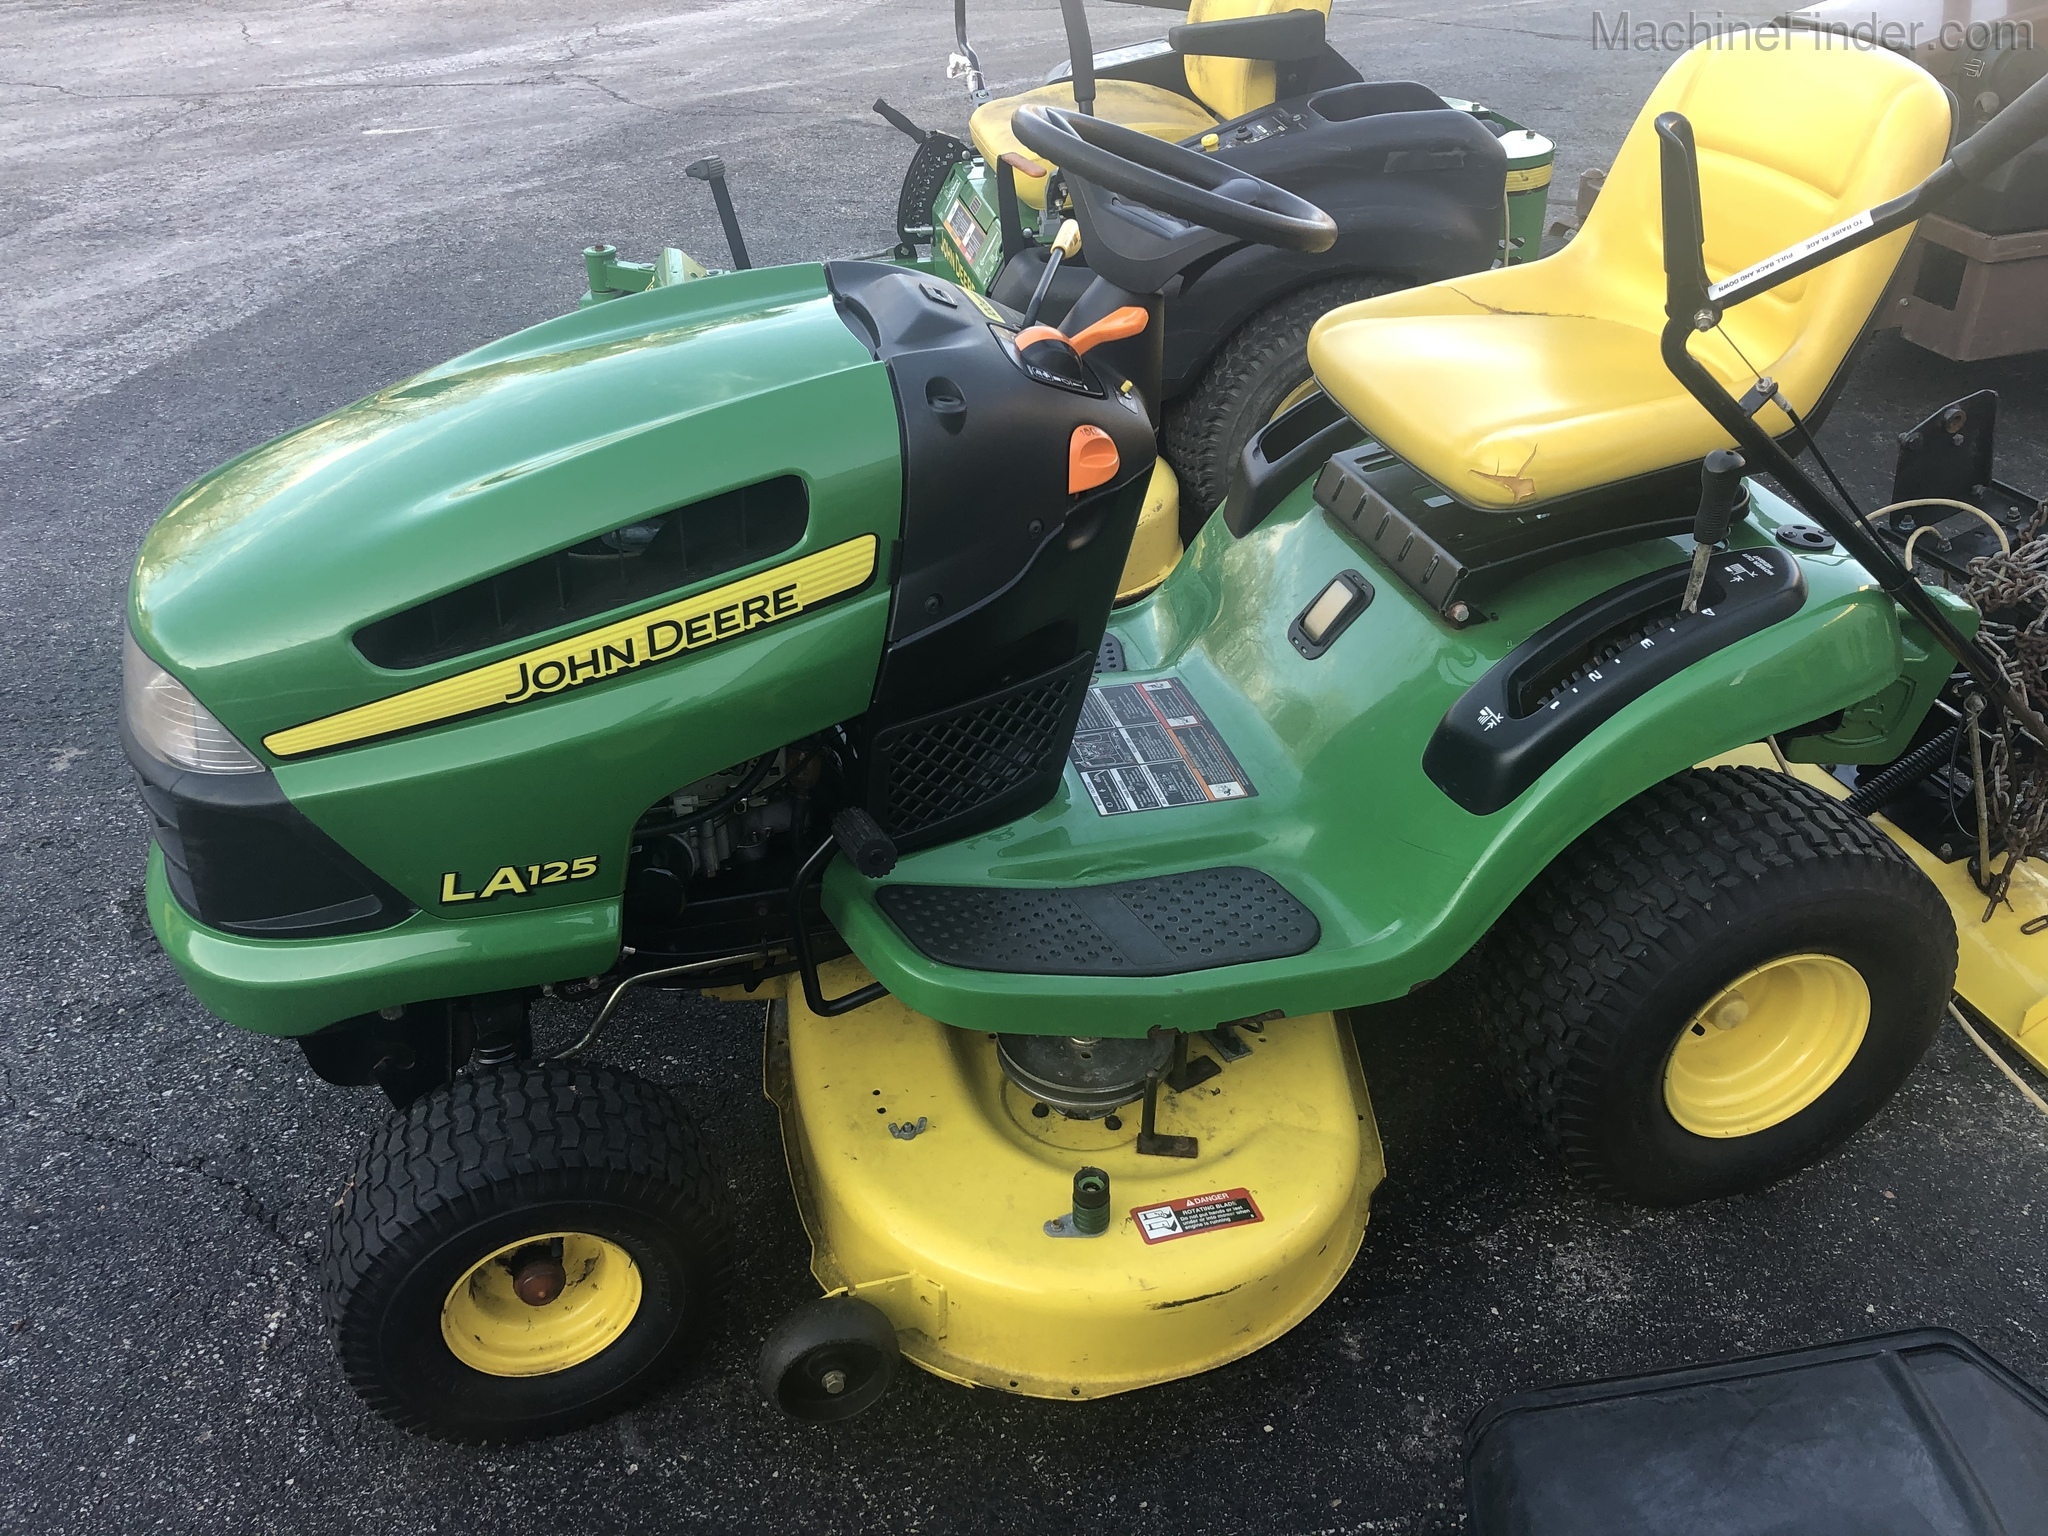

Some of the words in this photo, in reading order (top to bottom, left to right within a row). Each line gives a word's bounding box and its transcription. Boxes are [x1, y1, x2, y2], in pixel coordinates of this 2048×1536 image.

[1853, 219, 1863, 227] TO
[1831, 224, 1852, 238] RAISE
[1805, 235, 1830, 250] BLADE
[1775, 252, 1793, 263] PULL
[1756, 262, 1775, 274] BACK
[1740, 271, 1754, 282] AND
[1718, 278, 1739, 292] DOWN
[1741, 553, 1755, 562] CUT
[1752, 560, 1775, 576] MOWER
[1701, 607, 1716, 616] 4
[504, 636, 636, 702] JOHN
[646, 582, 801, 658] DEERE
[1640, 637, 1656, 650] 3
[1587, 669, 1603, 682] 2
[1549, 700, 1560, 710] 1
[441, 855, 598, 903] LA125
[1194, 1192, 1229, 1204] DANGER
[1182, 1205, 1215, 1215] ROTATING
[1210, 1217, 1231, 1225] running
